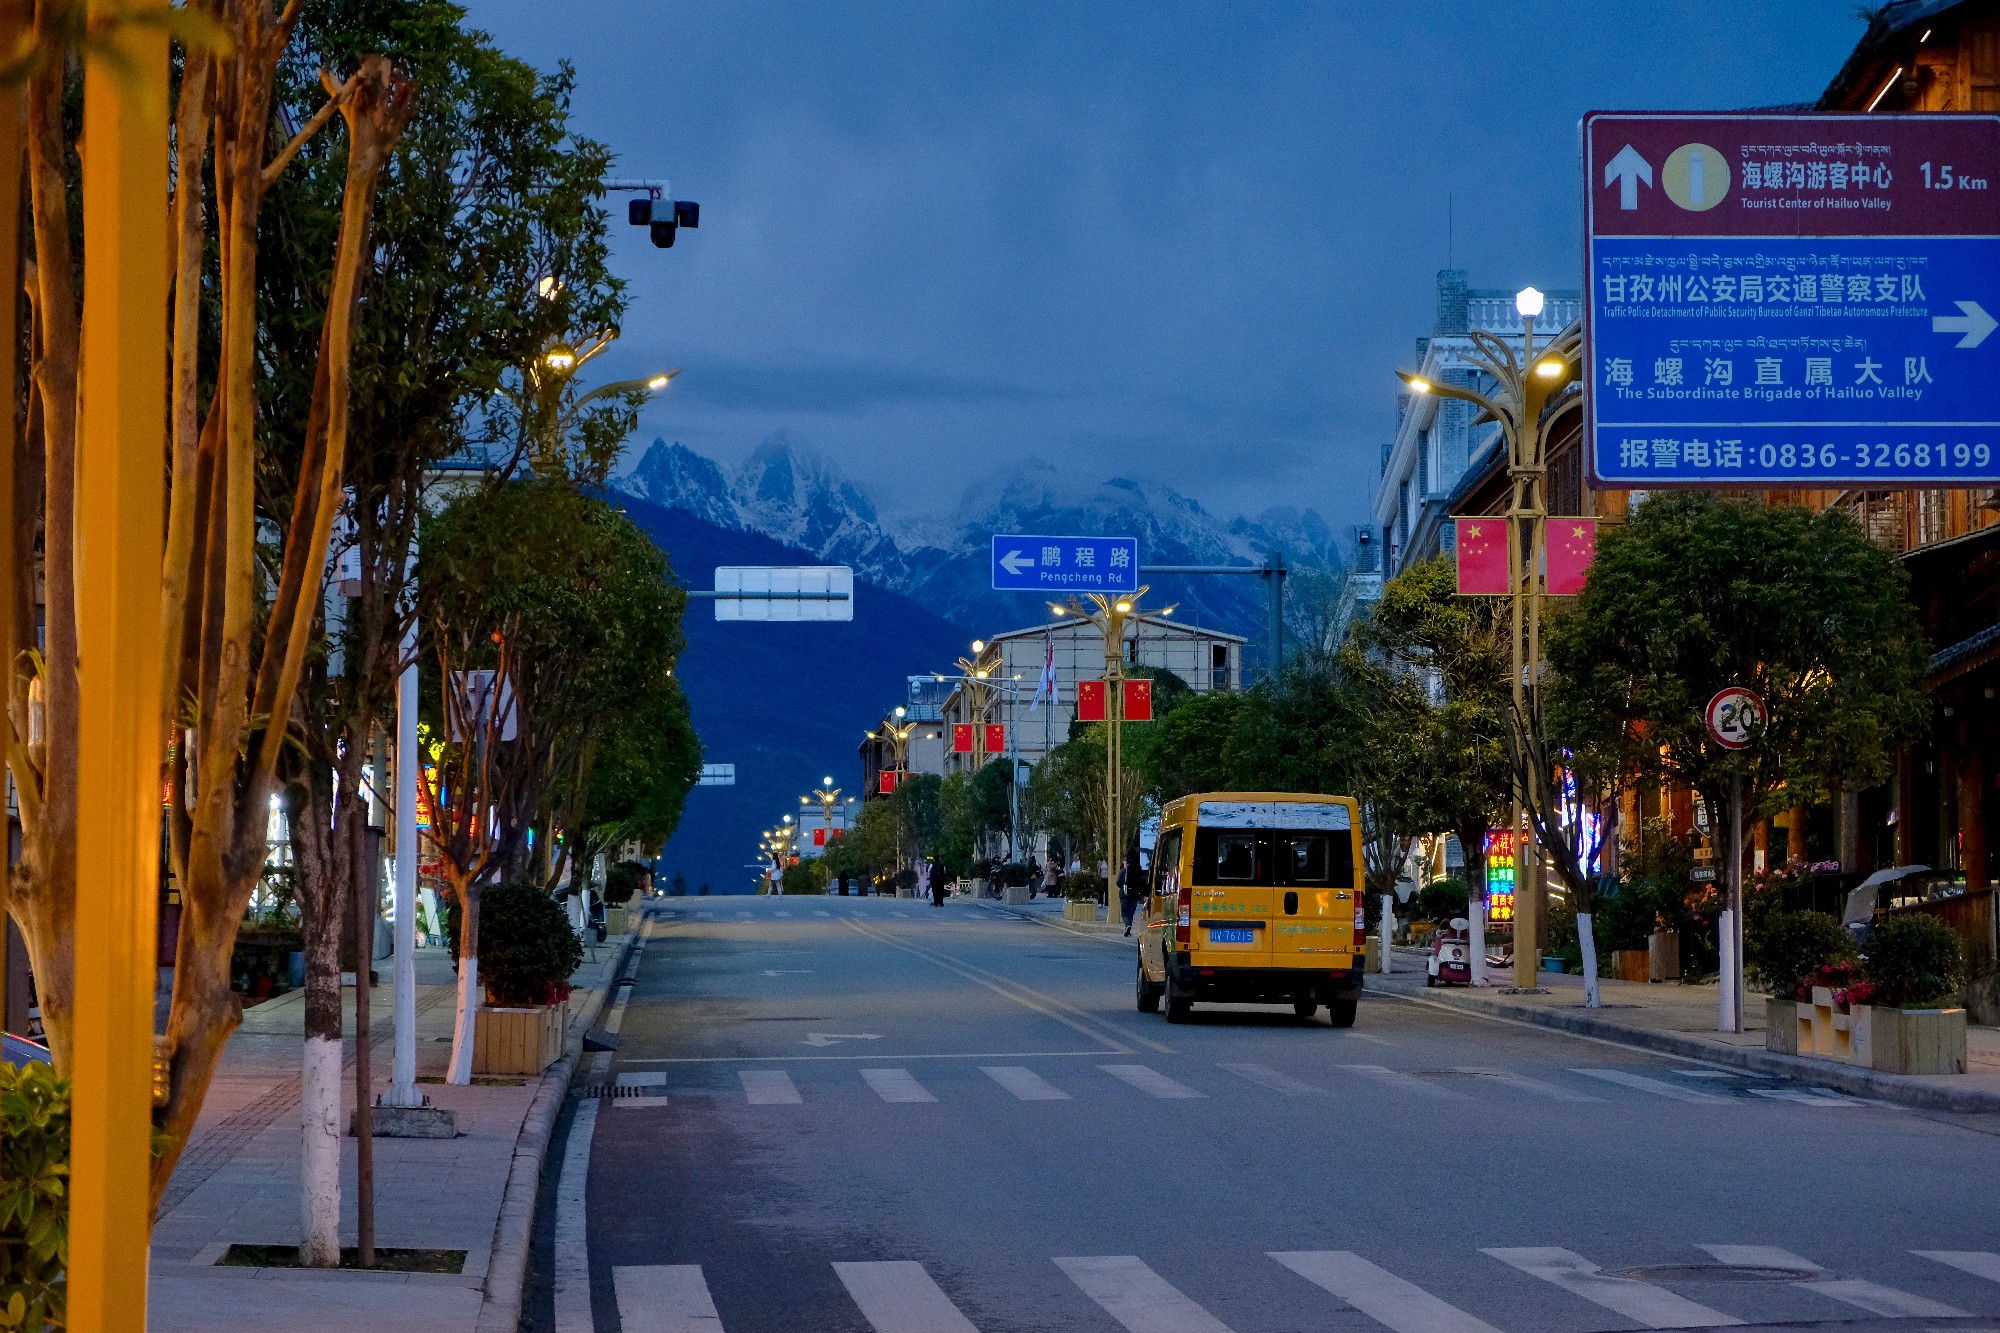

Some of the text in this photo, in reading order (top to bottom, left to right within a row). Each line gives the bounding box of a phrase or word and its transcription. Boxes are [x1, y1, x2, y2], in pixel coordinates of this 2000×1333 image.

[1741, 161, 1892, 190] 海螺沟游客中心
[1920, 161, 1988, 190] 1.5 Km
[1741, 197, 1892, 211] Tourist Center of Hailuo Valley
[1603, 274, 1927, 303] 甘孜州公安局交通警察支队
[1603, 305, 1928, 319] Traffic Police Detachment of Public Security Bureau of Ganzi Tibetan Autonomous Prefecture
[1605, 357, 1934, 386] 海螺沟直属大队
[1616, 387, 1923, 402] The Subordinate Brigade of Hailuo Valley
[1041, 546, 1130, 568] 鹏程路
[1040, 572, 1125, 584] Pengcheng Rd.
[1720, 703, 1755, 732] 20
[1491, 907, 1515, 919] 家常
